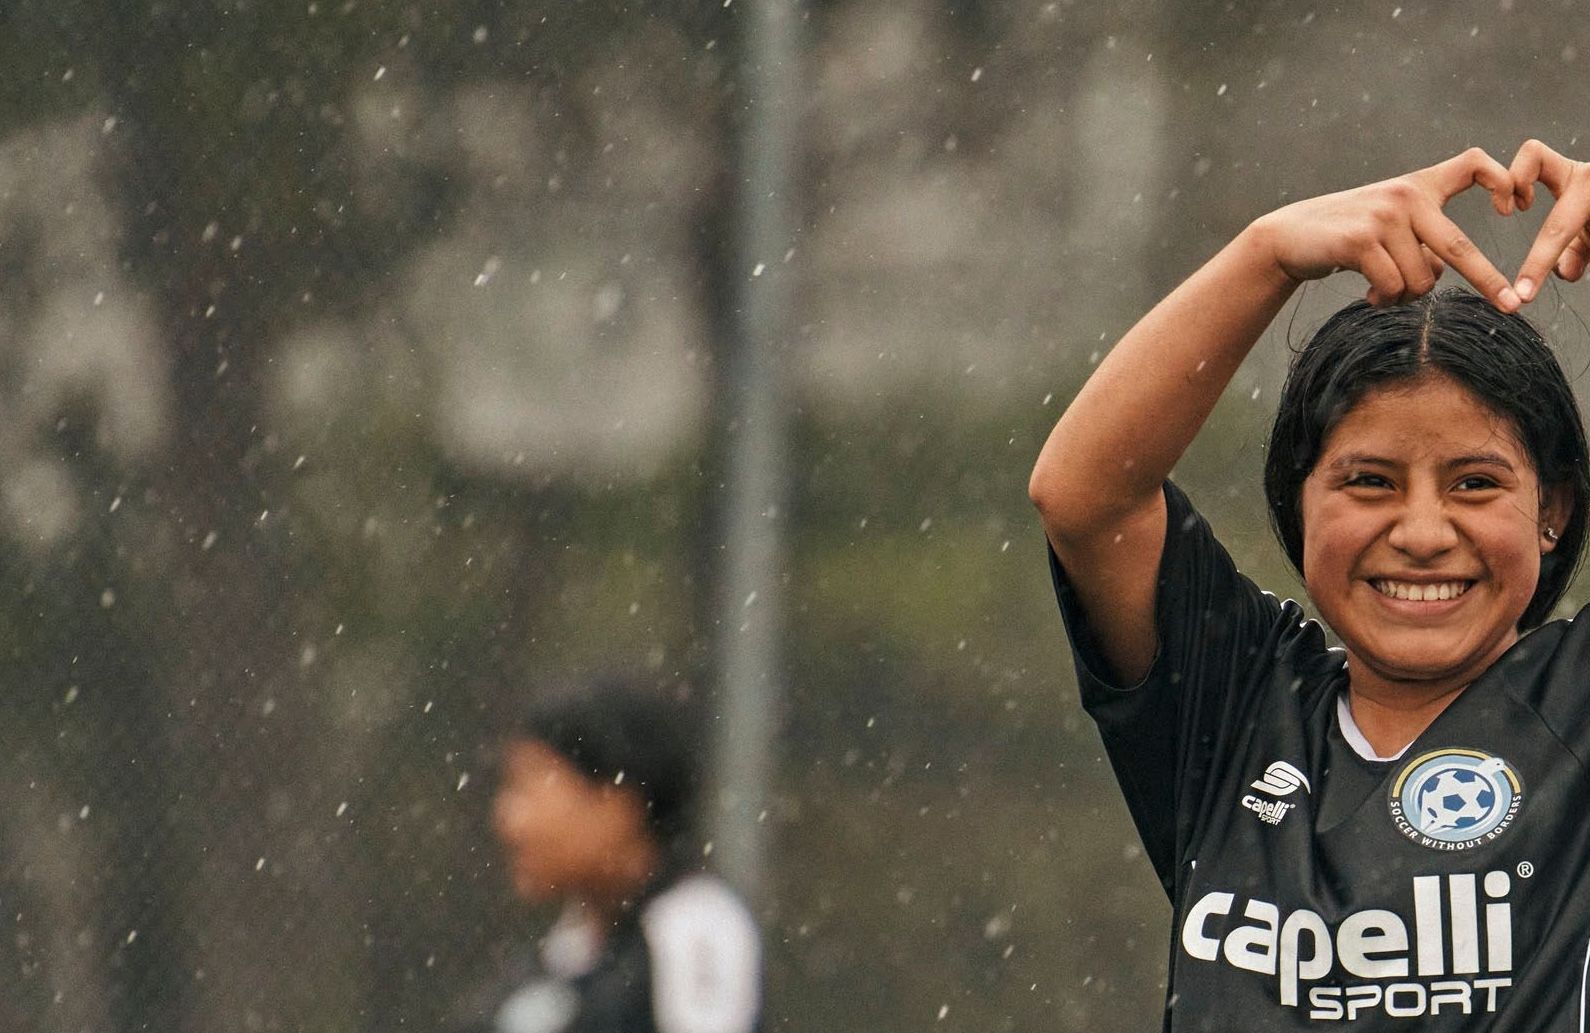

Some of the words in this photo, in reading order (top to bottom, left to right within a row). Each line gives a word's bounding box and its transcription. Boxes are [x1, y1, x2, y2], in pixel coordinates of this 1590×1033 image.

[1390, 801, 1419, 839] SOCCER
[1421, 838, 1482, 850] WITHOUT
[1486, 795, 1522, 840] BORDERS
[1309, 978, 1513, 1021] SPORT
